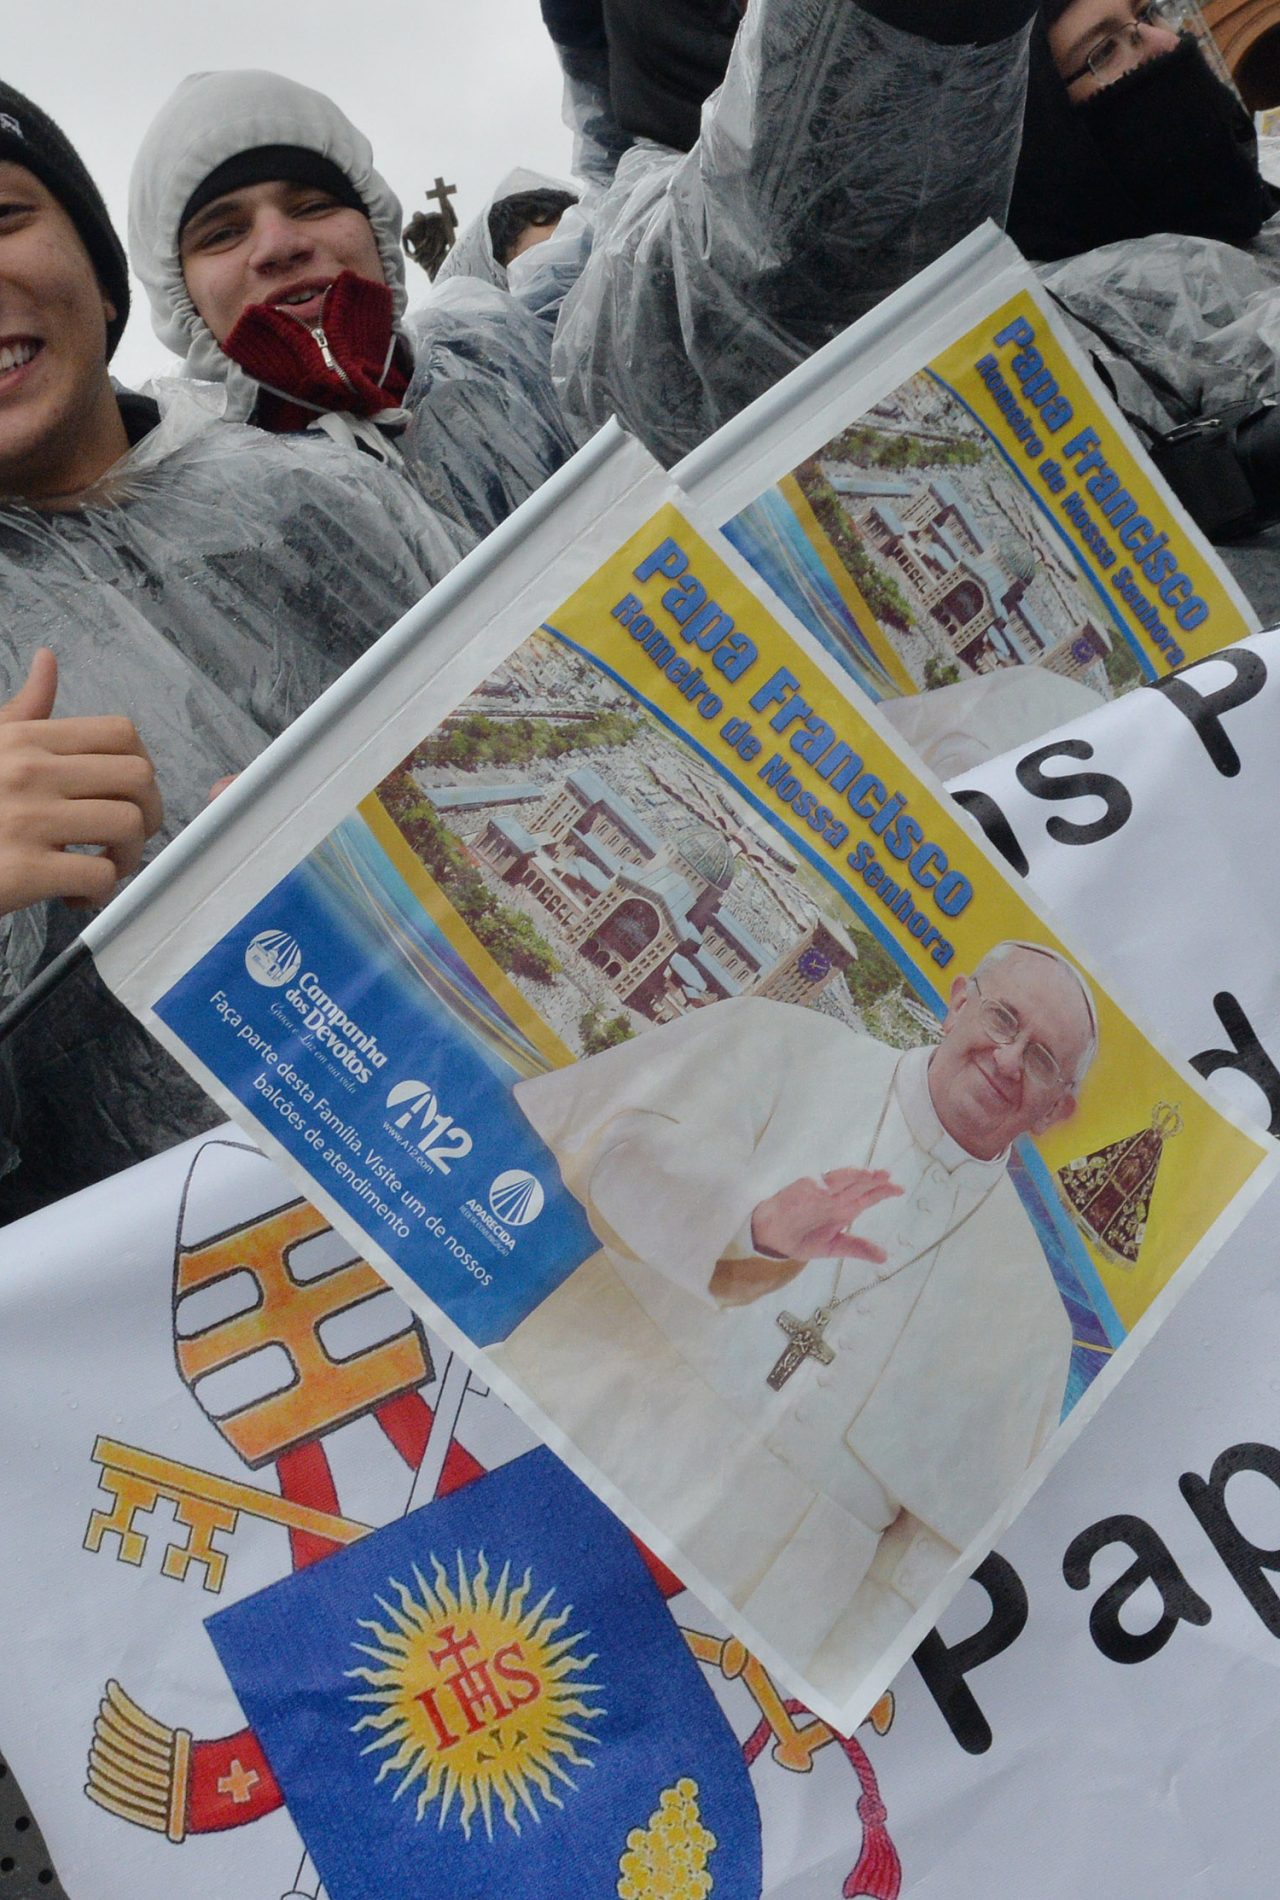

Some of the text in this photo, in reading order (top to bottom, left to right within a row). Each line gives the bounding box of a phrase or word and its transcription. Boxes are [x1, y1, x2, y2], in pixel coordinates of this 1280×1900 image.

[974, 352, 1186, 668] Romeiro de Nossa Senhora
[993, 314, 1210, 632] Papa Francisco
[610, 592, 955, 968] Romeiro de Nossa Senhora
[632, 536, 974, 918] Papa Francisco
[285, 989, 373, 1084] dos Devotos
[298, 972, 388, 1069] Campanha
[210, 990, 494, 1287] Faça parte desta Família. Visite um de nossos
[252, 1072, 410, 1239] balcões de atendimento
[382, 1121, 435, 1176] www.A12.com
[465, 1198, 516, 1251] APARECIDA
